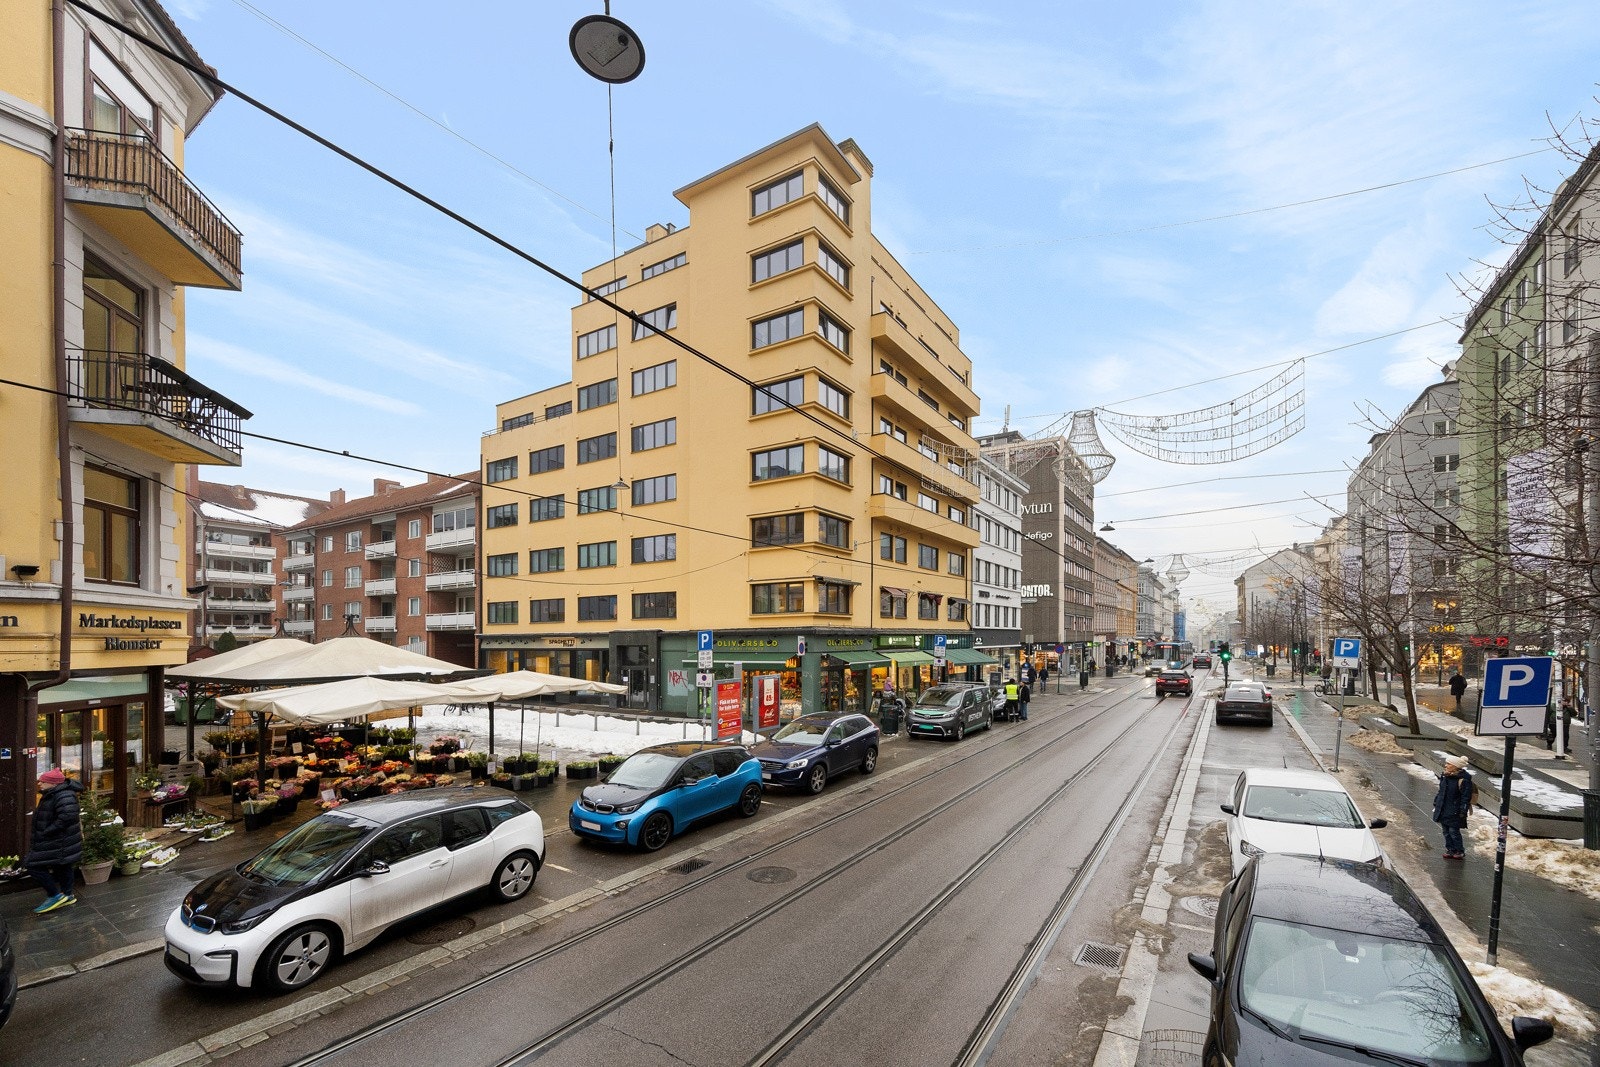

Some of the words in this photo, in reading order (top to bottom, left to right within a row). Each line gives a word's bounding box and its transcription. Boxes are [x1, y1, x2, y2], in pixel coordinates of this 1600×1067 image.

[1024, 531, 1053, 540] defigo
[1021, 584, 1054, 597] ONTOR.
[0, 615, 19, 627] n
[79, 613, 182, 632] Markedsplassen
[104, 637, 163, 651] Blomster
[702, 633, 709, 648] P
[1340, 641, 1354, 655] P
[1499, 664, 1535, 700] P
